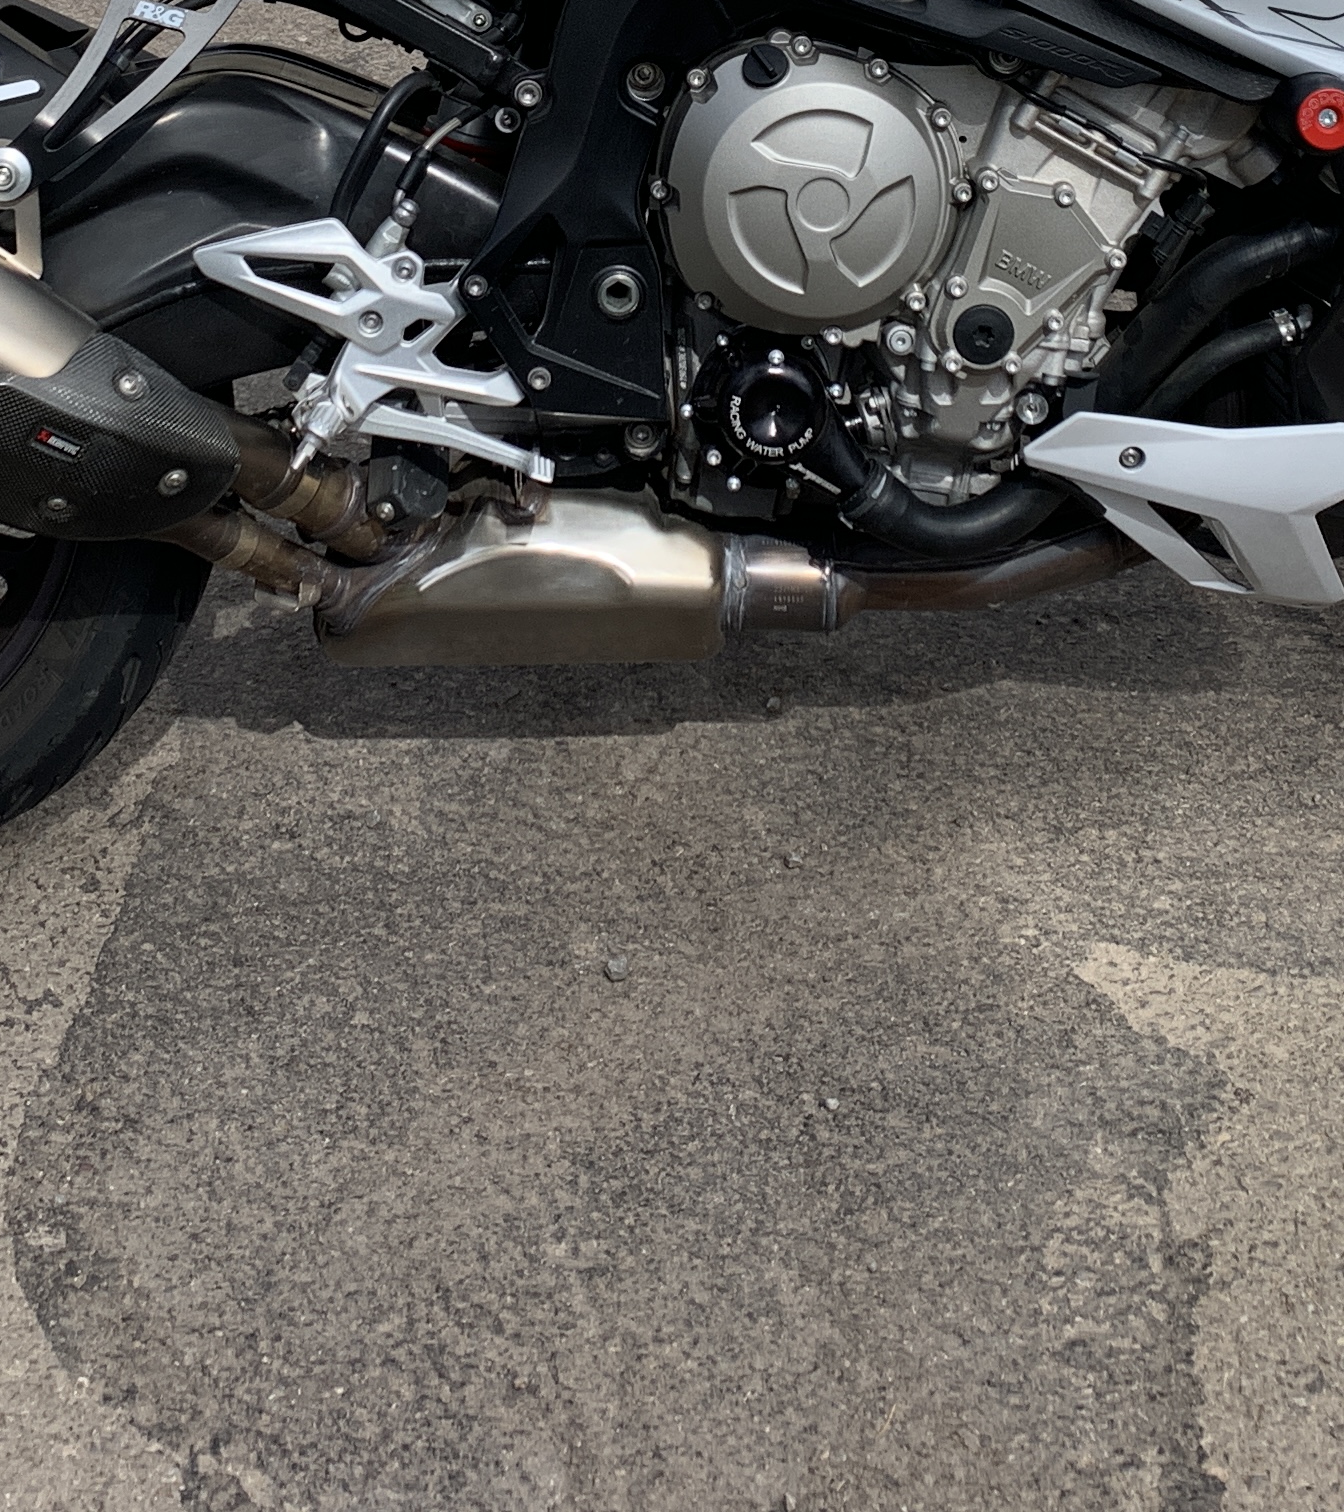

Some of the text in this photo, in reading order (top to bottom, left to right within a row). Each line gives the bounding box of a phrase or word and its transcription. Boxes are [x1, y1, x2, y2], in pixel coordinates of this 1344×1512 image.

[133, 0, 185, 29] R&G
[994, 248, 1052, 290] BMW
[729, 394, 814, 458] RACING WATER PUMP
